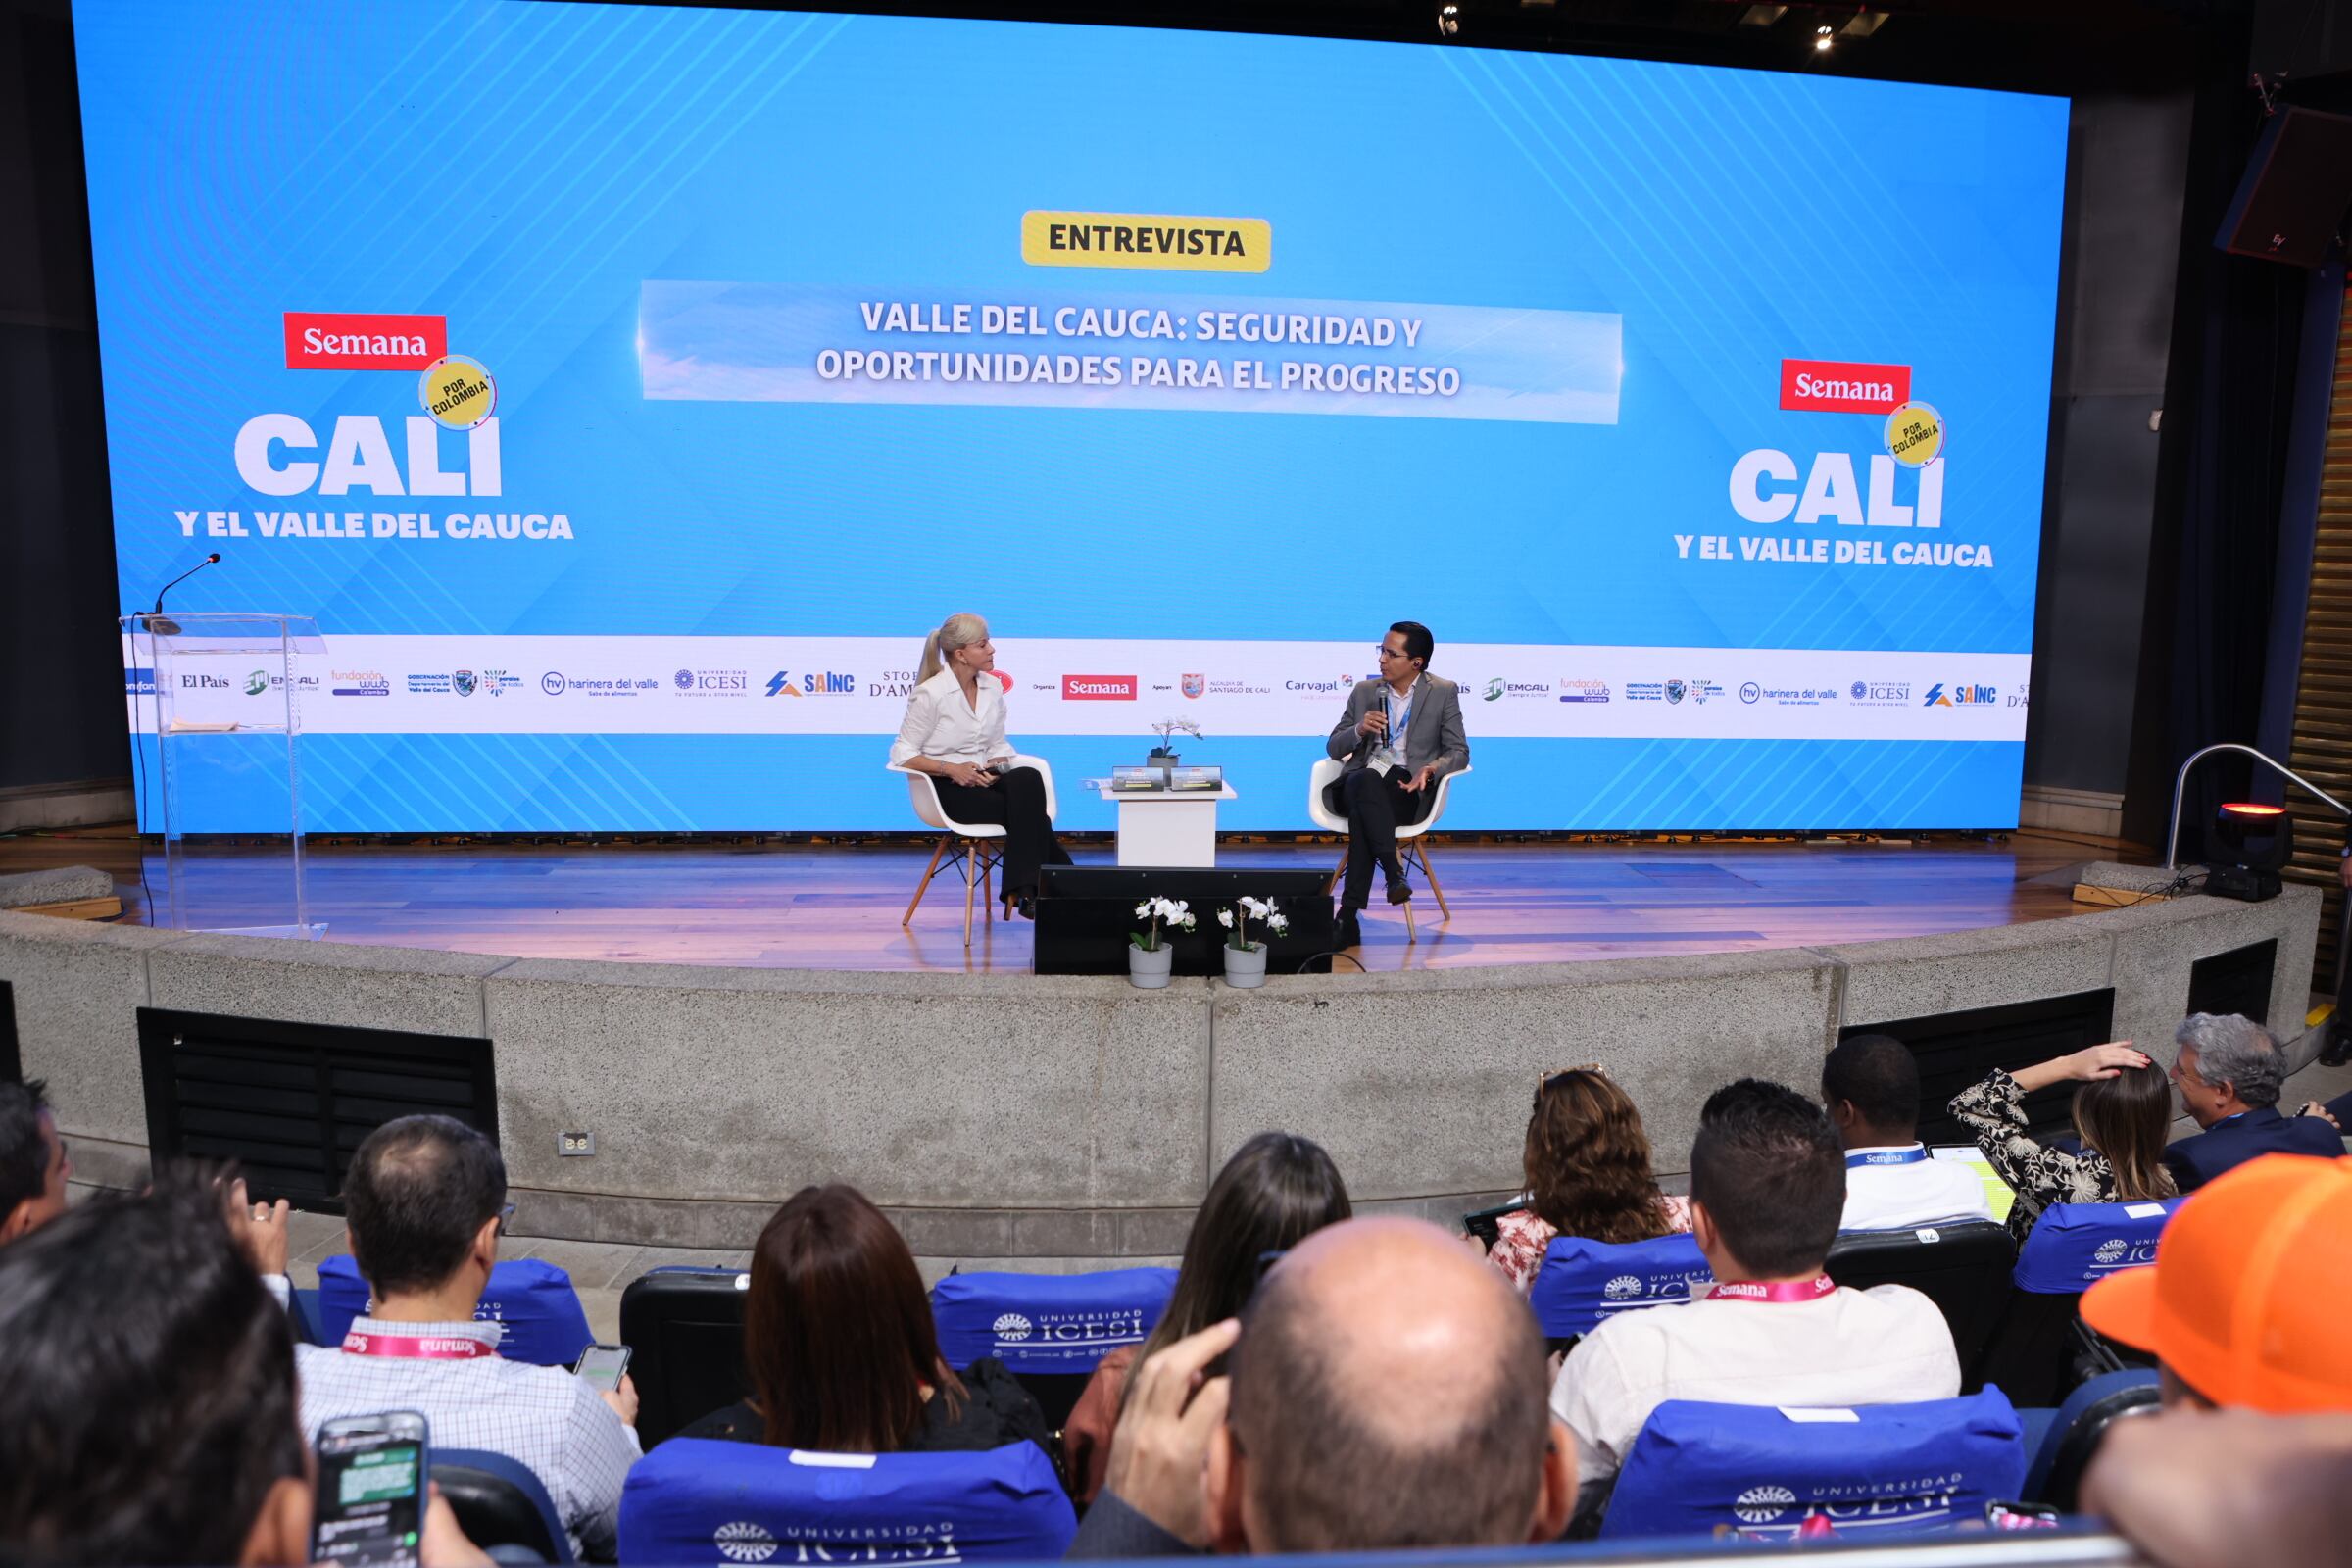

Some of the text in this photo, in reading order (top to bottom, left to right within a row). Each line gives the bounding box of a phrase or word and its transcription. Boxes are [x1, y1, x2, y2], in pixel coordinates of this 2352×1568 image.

[1049, 222, 1246, 257] ENTREVISTA
[860, 301, 1424, 347] VALLE DEL CAUCA: SEGURIDAD Y
[304, 327, 428, 357] Semana
[816, 348, 1461, 396] OPORTUNIDADES PARA EL PROGRESO
[442, 376, 466, 398] POR
[1795, 372, 1894, 402] Semana
[431, 379, 489, 416] COLOMBIA
[1902, 421, 1923, 438] POR
[1892, 423, 1939, 455] COLOMBIA
[234, 412, 503, 497] CALI
[1729, 448, 1945, 528] CALI
[174, 510, 574, 540] Y EL VALLE DEL CAUCA
[1673, 534, 1994, 568] Y EL VALLE DEL CAUCA
[181, 674, 230, 688] El País
[271, 676, 319, 685] EALI
[331, 669, 382, 681] fundación
[546, 677, 562, 689] hv
[568, 678, 659, 689] harinera del valle
[698, 676, 747, 689] ICESI
[1069, 680, 1130, 696] Semana
[1285, 680, 1338, 693] Carvajal
[1744, 688, 1757, 697] hv
[1763, 688, 1838, 699] harinera del valle
[1869, 687, 1910, 700] ICESI
[1865, 1154, 1903, 1163] Semana
[1650, 1269, 1711, 1282] UNIVRSI
[1717, 1284, 1768, 1298] Semana
[1040, 1308, 1143, 1323] UNIVERSIDAD
[1041, 1319, 1144, 1341] ICESI
[419, 1338, 476, 1356] Semana
[1813, 1472, 1963, 1496] UNIVERSIDAD
[787, 1521, 954, 1539] UNIVERSIDAD
